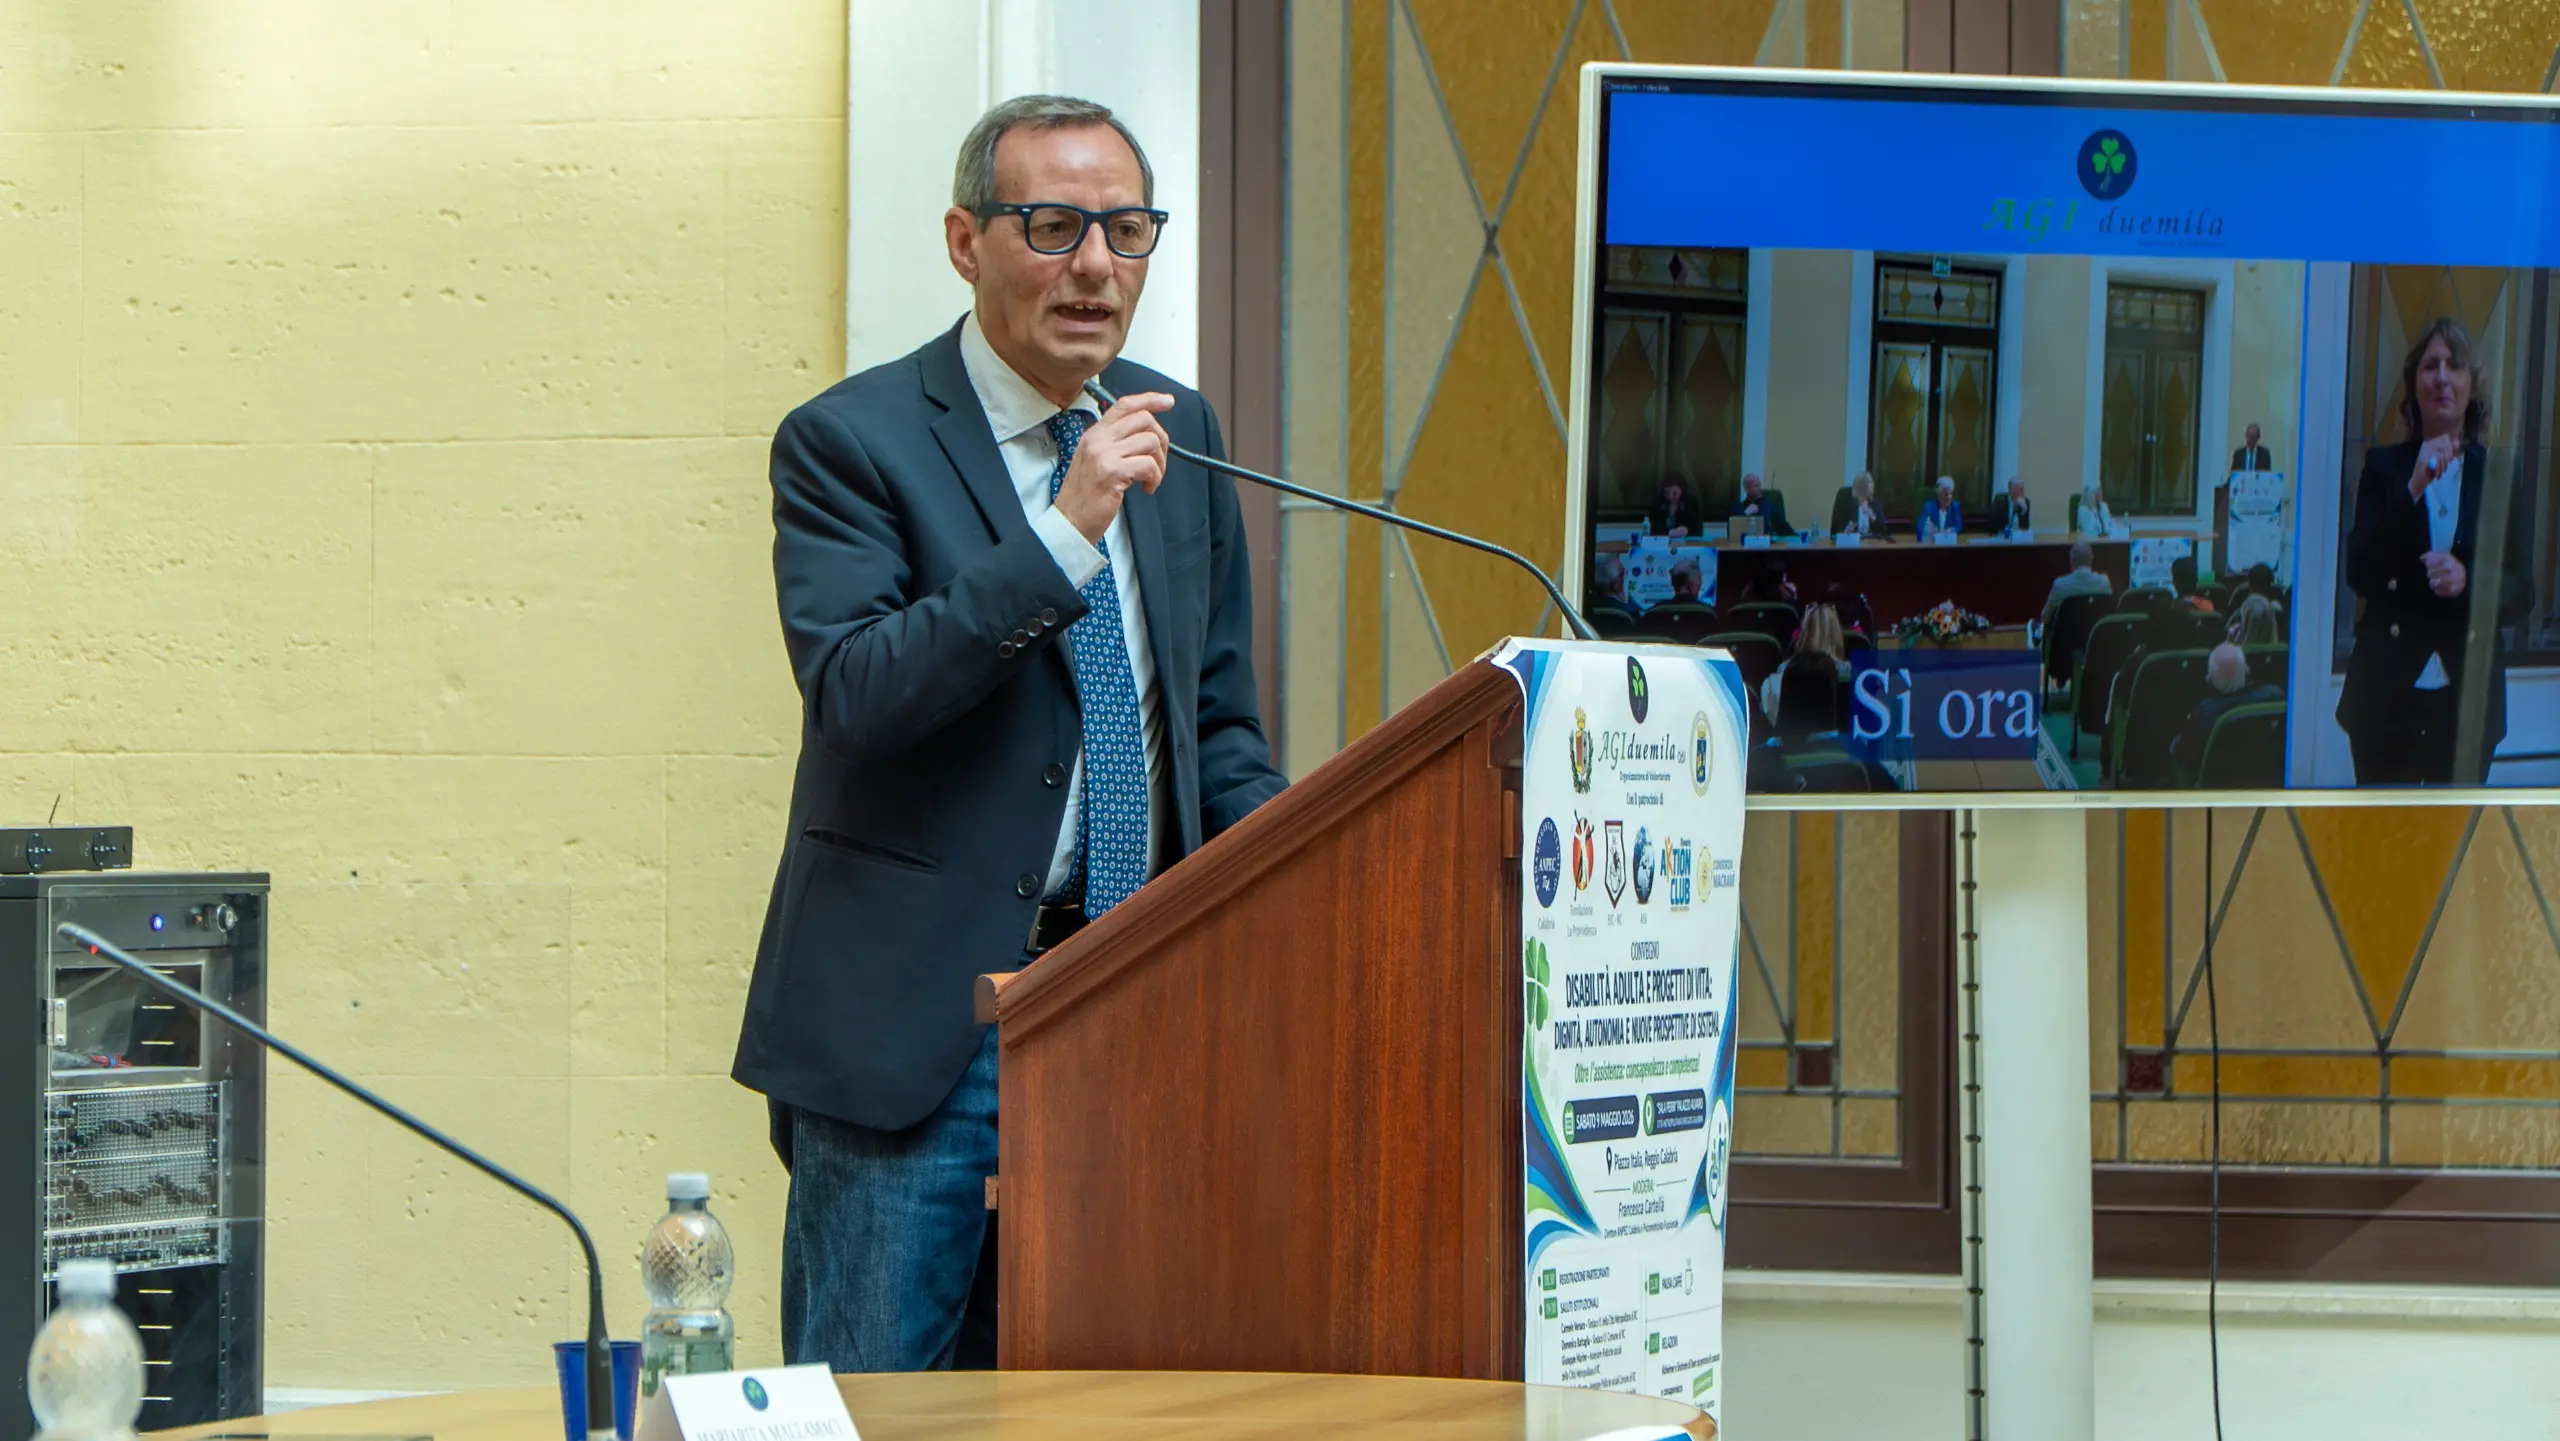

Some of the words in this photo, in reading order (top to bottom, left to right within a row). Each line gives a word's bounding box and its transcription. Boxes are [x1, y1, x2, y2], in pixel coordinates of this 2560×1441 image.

[1981, 198, 2078, 244] AGI
[2098, 205, 2223, 236] duemila
[1853, 668, 1915, 740] Sì
[1938, 689, 2038, 739] ora
[1660, 841, 1691, 880] AKTION
[1670, 877, 1691, 905] CLUB
[1570, 904, 1593, 916] Fondazione
[1631, 941, 1659, 961] CONVEGNO
[1566, 965, 1611, 1008] DISABILITÀ
[1613, 970, 1645, 1005] ADULTA
[1646, 970, 1651, 1003] E
[1652, 968, 1685, 1002] PROGETTI
[1686, 967, 1694, 1001] DI
[1694, 966, 1713, 1000] VITA:
[1554, 1013, 1583, 1052] DIGNITÀ,
[1584, 1017, 1625, 1048] AUTONOMIA
[1625, 1017, 1630, 1044] E
[1631, 1015, 1652, 1043] NUOVE
[1653, 1013, 1689, 1042] PROSPETTIVE
[1690, 1012, 1697, 1039] DI
[1697, 1010, 1720, 1038] SISTEMA
[1575, 1062, 1589, 1083] Oltre
[1625, 1056, 1665, 1083] consapevolezza
[1576, 1112, 1596, 1130] SABATO
[1596, 1112, 1600, 1128] 9
[1600, 1110, 1621, 1128] MAGGIO
[1621, 1109, 1634, 1125] 2026
[1614, 1153, 1630, 1170] Piazza
[1645, 1150, 1660, 1170] Reggio
[1660, 1147, 1678, 1164] Calabria
[1618, 1202, 1644, 1219] Francesca
